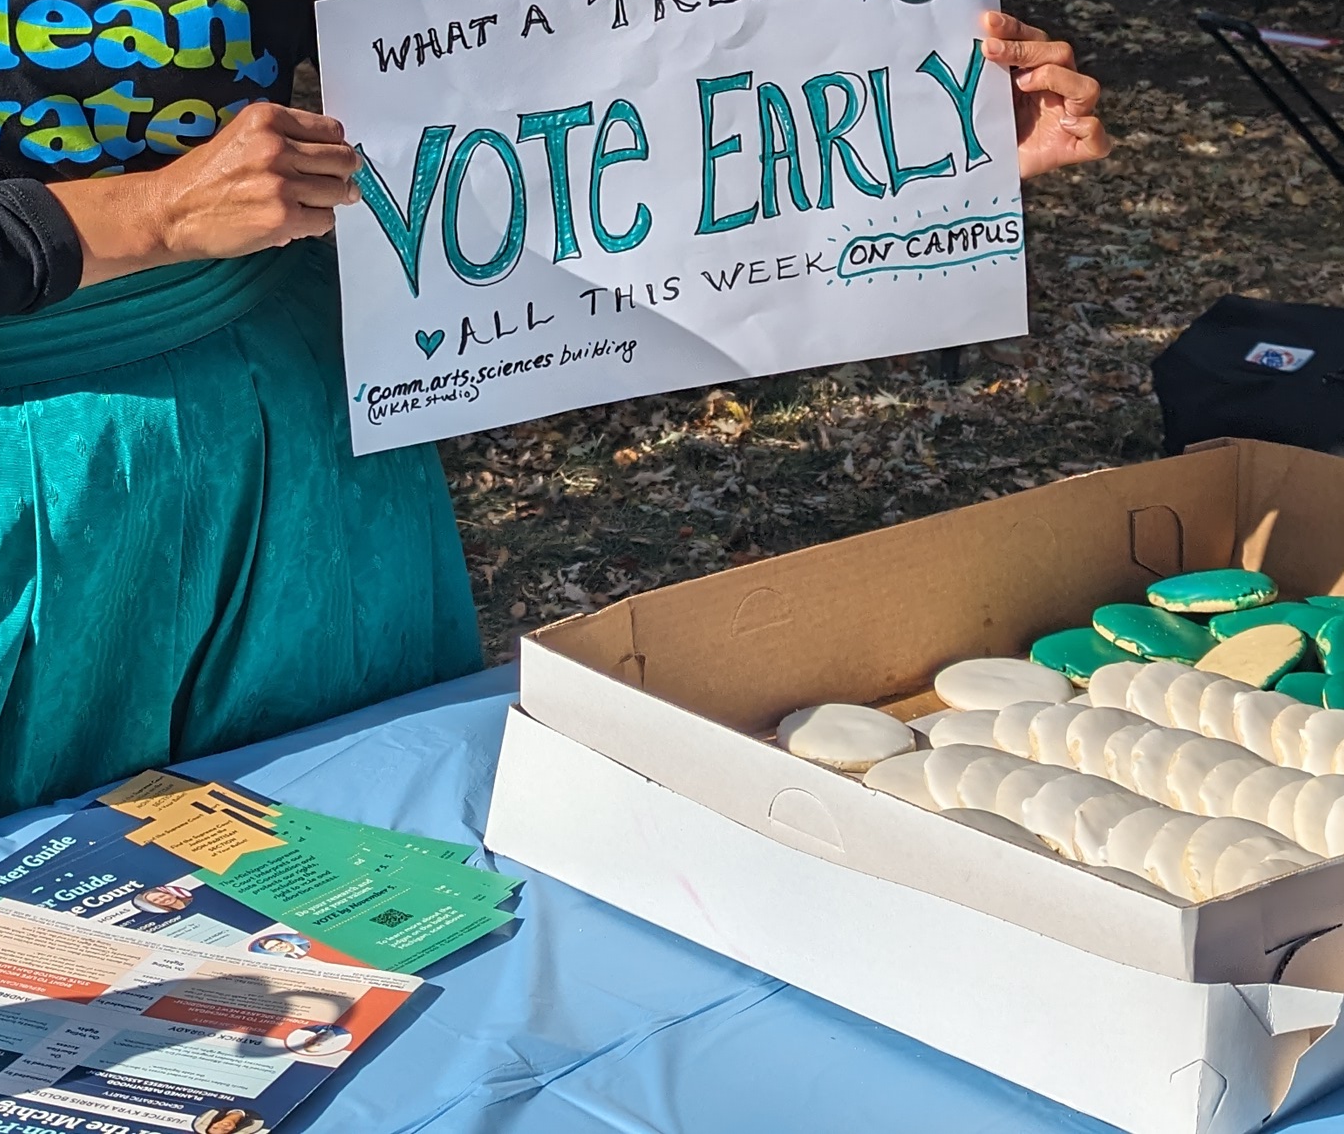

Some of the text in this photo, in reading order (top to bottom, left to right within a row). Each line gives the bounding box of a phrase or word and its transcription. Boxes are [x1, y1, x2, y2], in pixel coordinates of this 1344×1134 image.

[372, 13, 498, 73] WHAT
[521, 5, 555, 37] A
[696, 39, 992, 236] EARLY
[457, 220, 1020, 356] ALL THIS WEEK ON CAMPUS
[559, 339, 637, 366] building
[368, 384, 479, 425] (WKAR studio)
[23, 834, 76, 868] Guide
[217, 848, 301, 886] The Michigan Supreme
[54, 872, 117, 902] Guide
[82, 879, 144, 909] Court
[293, 877, 374, 917] Do your research and
[97, 907, 131, 925] HOMAS
[312, 906, 332, 916] vote
[328, 897, 350, 908] your
[312, 912, 340, 926] VOTE
[335, 906, 353, 915] by
[347, 887, 390, 909] November
[166, 1025, 263, 1046] PATRICK O'GRADY
[104, 1078, 165, 1094] PARENTHOOD
[141, 1079, 175, 1089] NURSES
[162, 1089, 203, 1101] PLANNED
[173, 1085, 219, 1098] MICHIGAN
[217, 1093, 236, 1101] THE
[23, 1088, 187, 1124] JUSTICE KYRA HARRIS BOLDEN
[100, 1089, 185, 1110] DEMOCRATIC PARTY
[85, 1121, 119, 1134] the
